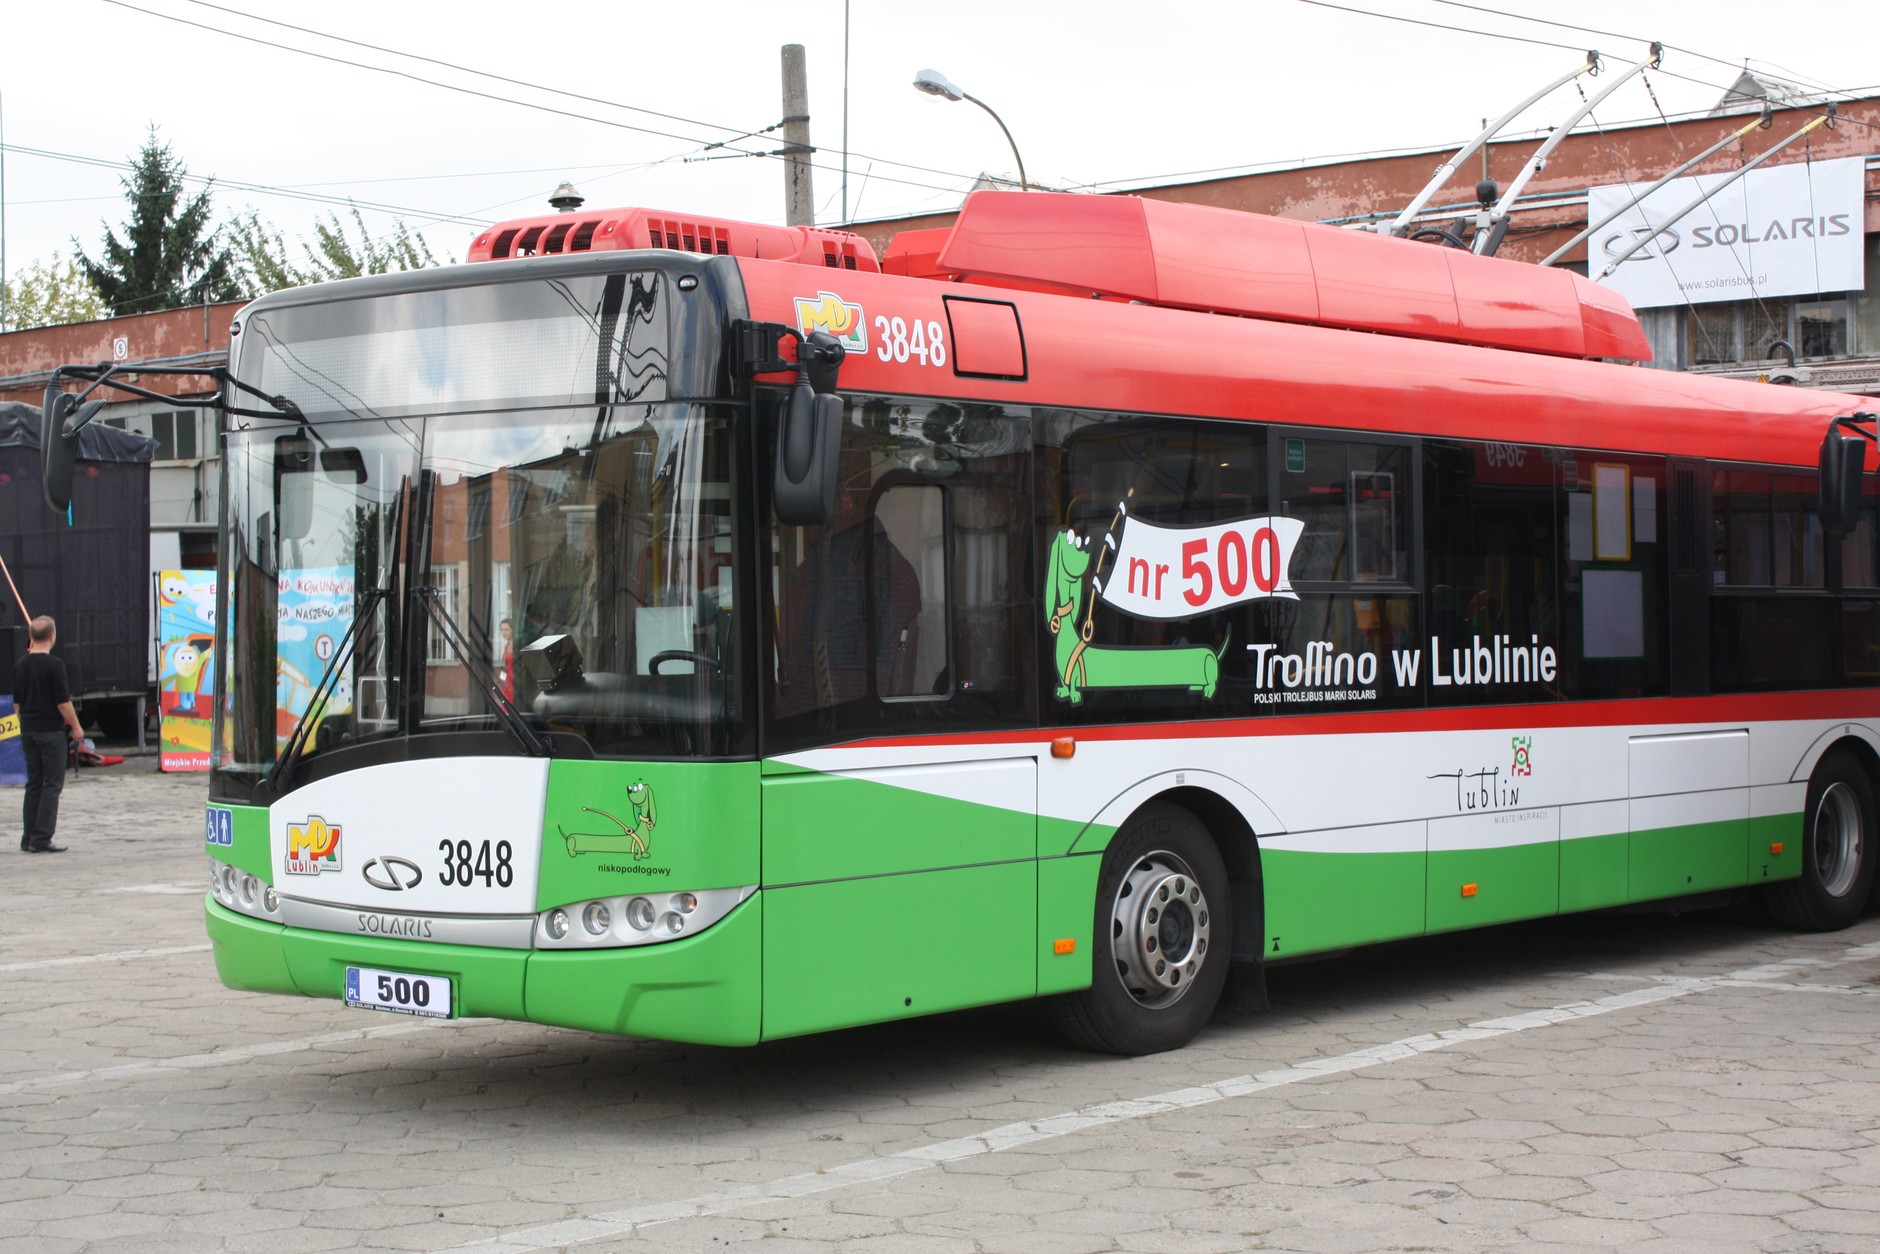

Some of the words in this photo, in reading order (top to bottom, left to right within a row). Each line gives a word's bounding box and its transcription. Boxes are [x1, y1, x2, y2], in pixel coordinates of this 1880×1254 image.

[1692, 214, 1850, 248] SOLARIS
[1677, 273, 1767, 291] www.solarisbus.pl
[118, 344, 123, 354] 5
[875, 315, 946, 367] 3848
[1128, 556, 1169, 600] nr
[1182, 527, 1281, 607] 500
[296, 604, 335, 620] NASZEGO
[321, 641, 329, 656] T
[1246, 641, 1377, 689] Trollino
[1392, 650, 1421, 687] w
[1431, 634, 1557, 686] Lublinie
[1254, 693, 1281, 704] POLSKI
[1283, 690, 1323, 703] TROLEJBUS
[1325, 690, 1347, 701] MARKI
[1348, 689, 1377, 700] SOLARIS
[1494, 814, 1516, 825] MIASTO
[287, 858, 319, 873] Lublin
[438, 838, 513, 888] 3848
[598, 863, 671, 877] niskopodłogowy
[358, 913, 432, 938] SOLARIS
[348, 987, 359, 999] PL
[377, 975, 430, 1007] 500
